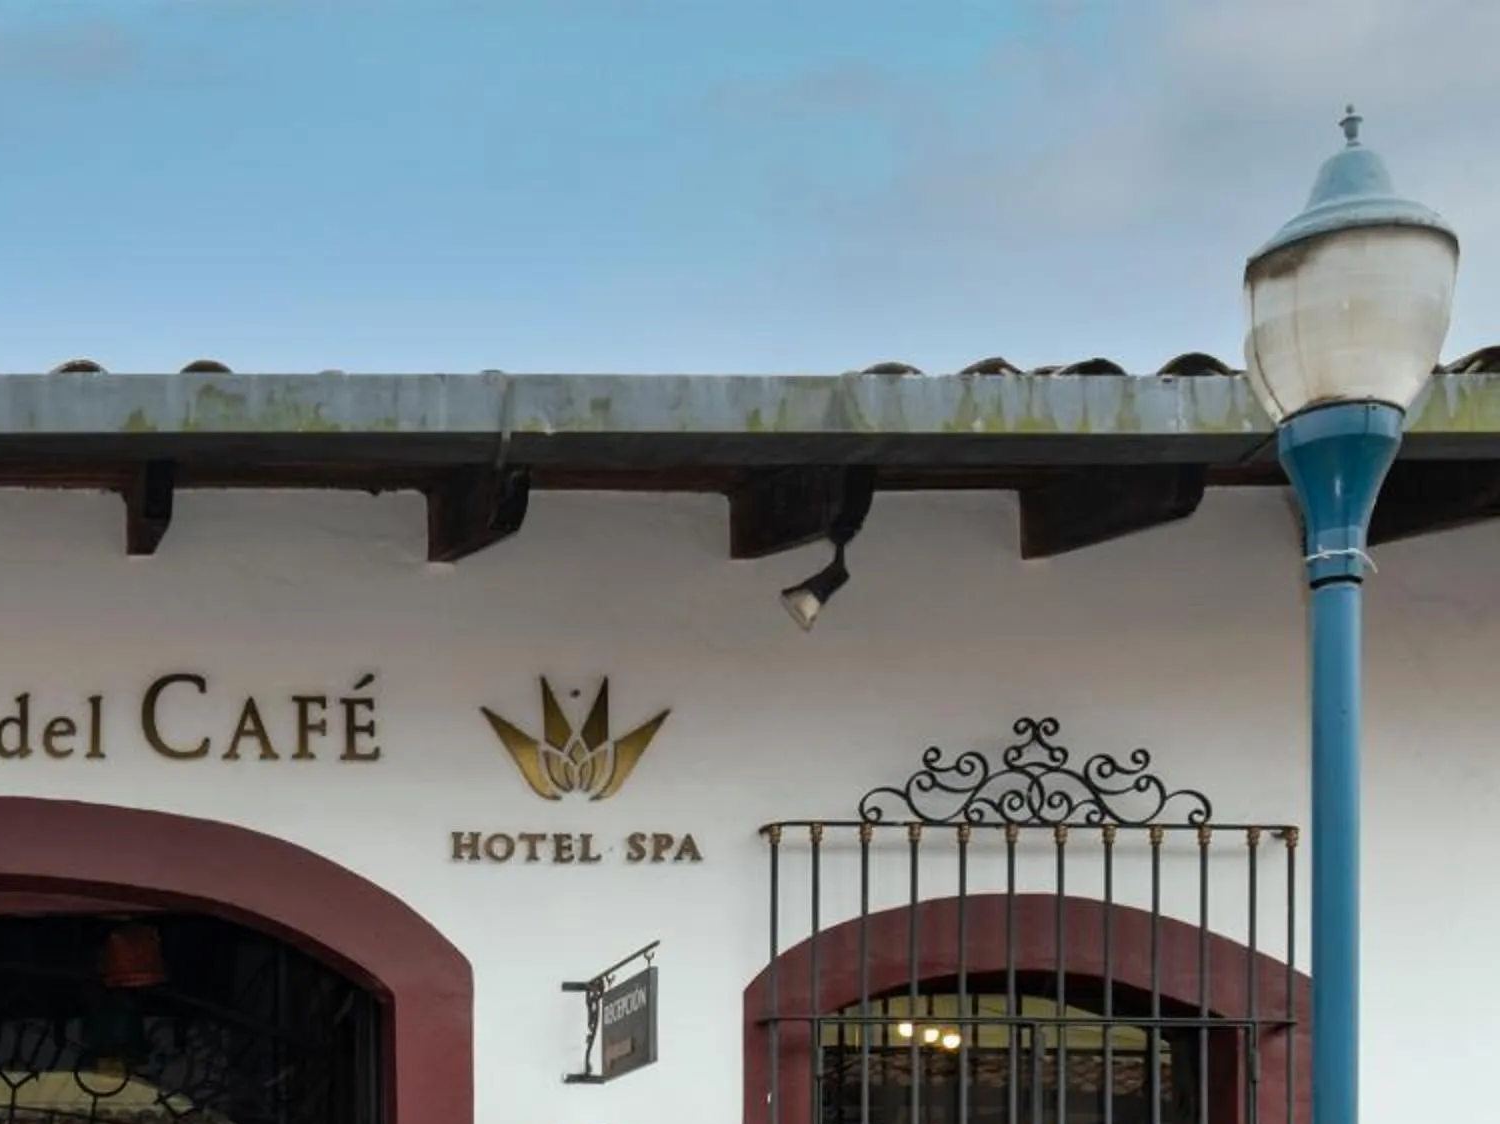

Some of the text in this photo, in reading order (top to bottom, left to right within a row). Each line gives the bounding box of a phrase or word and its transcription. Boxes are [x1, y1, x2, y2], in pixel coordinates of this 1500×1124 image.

[140, 671, 383, 762] CAFÉ
[451, 831, 703, 864] HOTEL SPA
